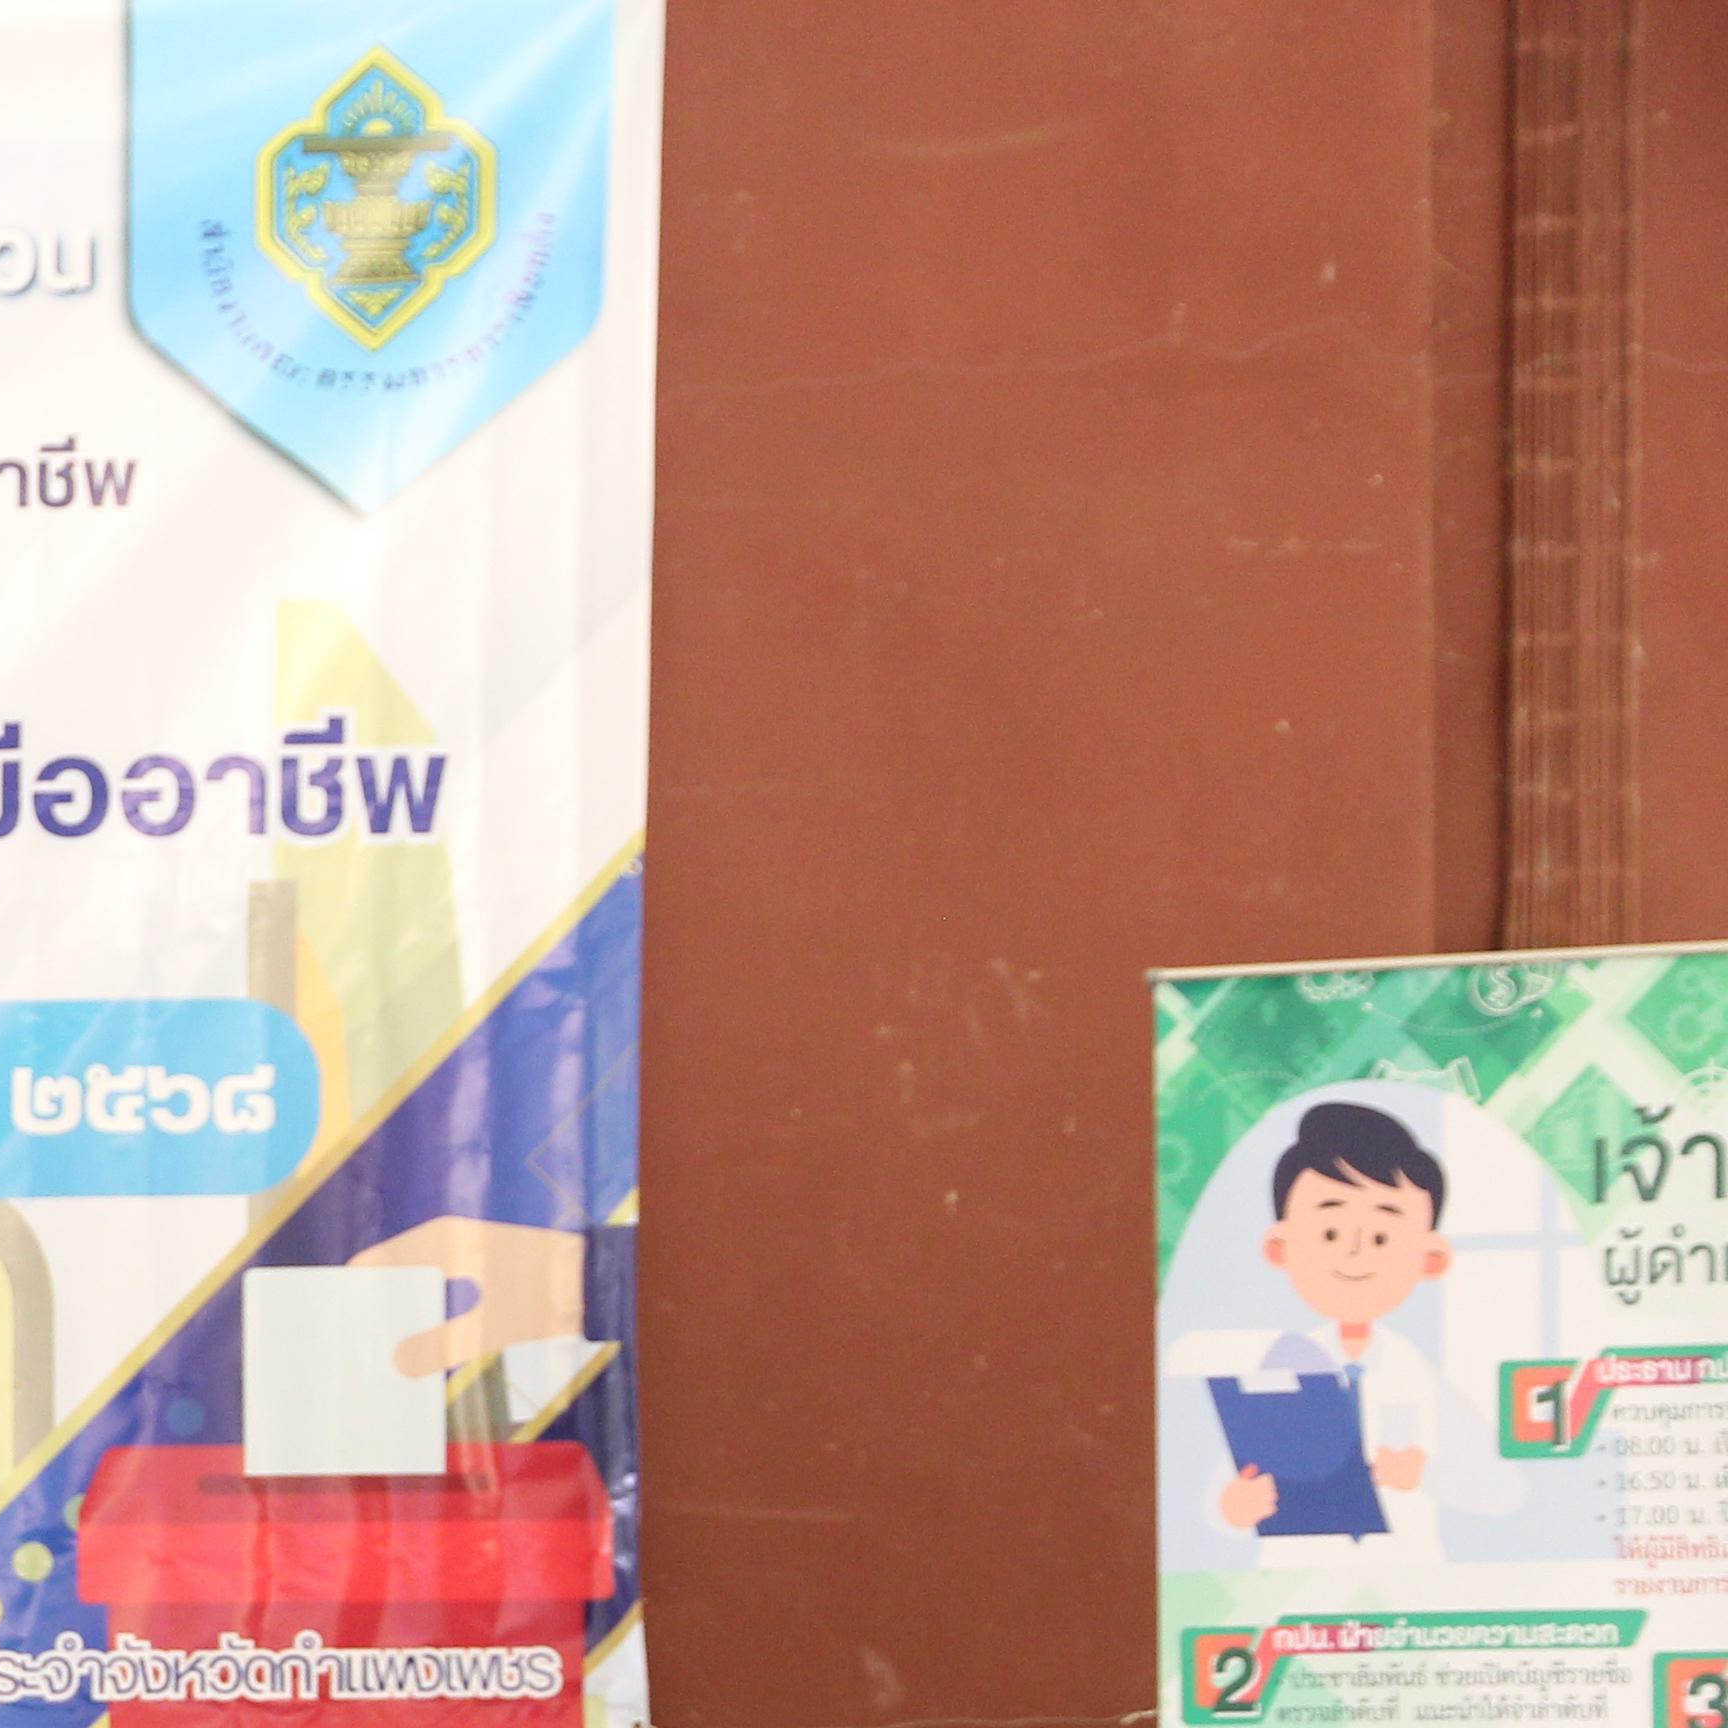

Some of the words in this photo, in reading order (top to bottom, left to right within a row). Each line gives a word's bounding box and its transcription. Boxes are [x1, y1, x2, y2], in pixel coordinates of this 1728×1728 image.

[9, 1057, 276, 1138] ๒๕๖๘
[1536, 1379, 1564, 1446] 1
[1212, 1646, 1259, 1713] 2
